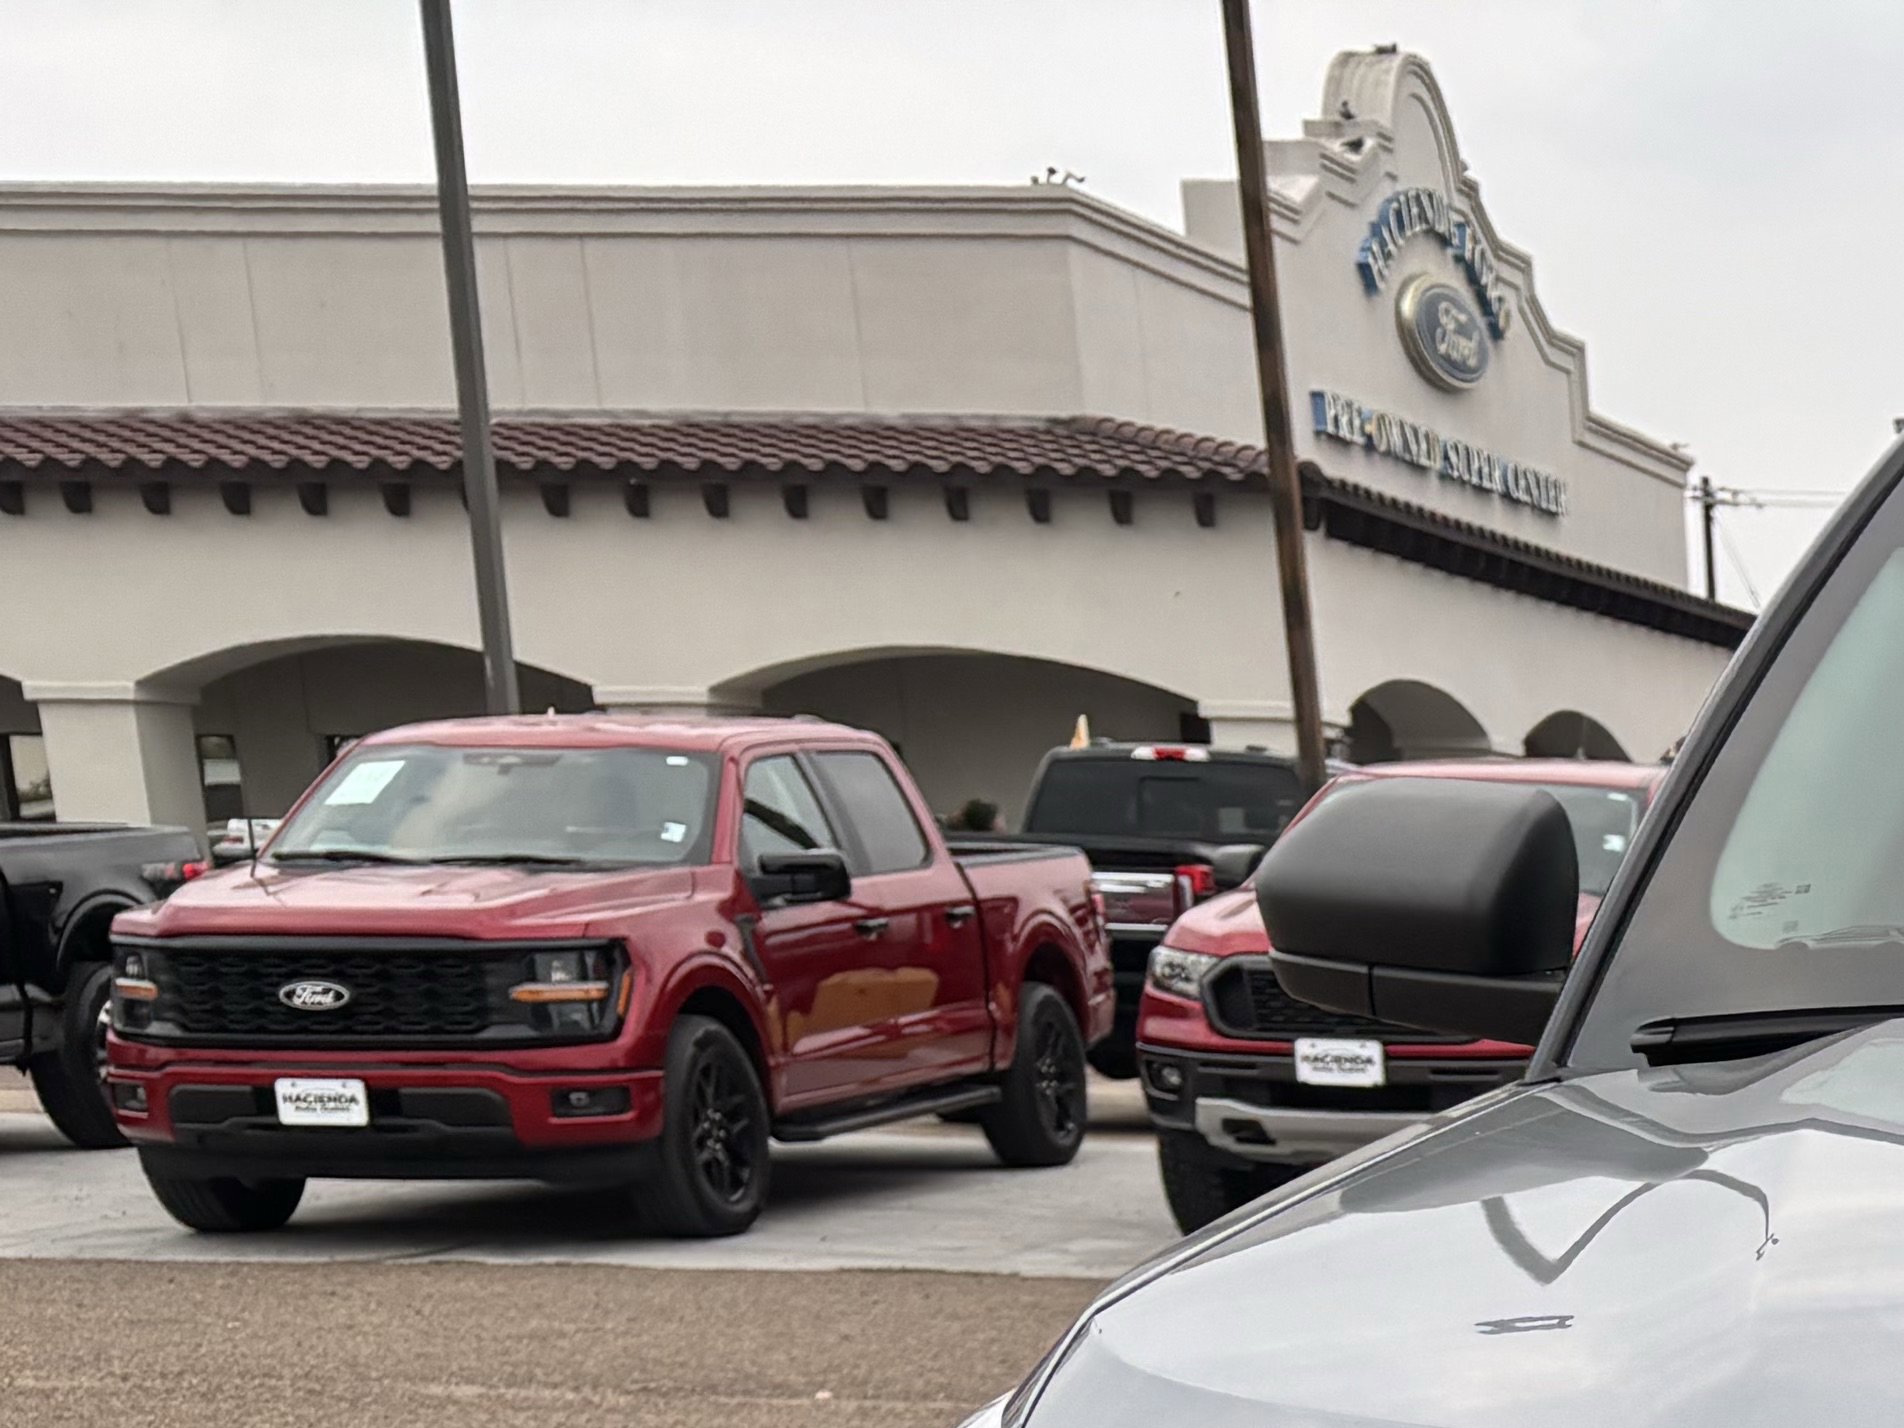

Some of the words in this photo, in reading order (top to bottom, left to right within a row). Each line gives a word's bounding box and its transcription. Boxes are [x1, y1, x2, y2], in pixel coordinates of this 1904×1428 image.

[1434, 301, 1480, 368] Ford
[293, 984, 336, 1006] Ford
[282, 1093, 360, 1106] HACIENDA
